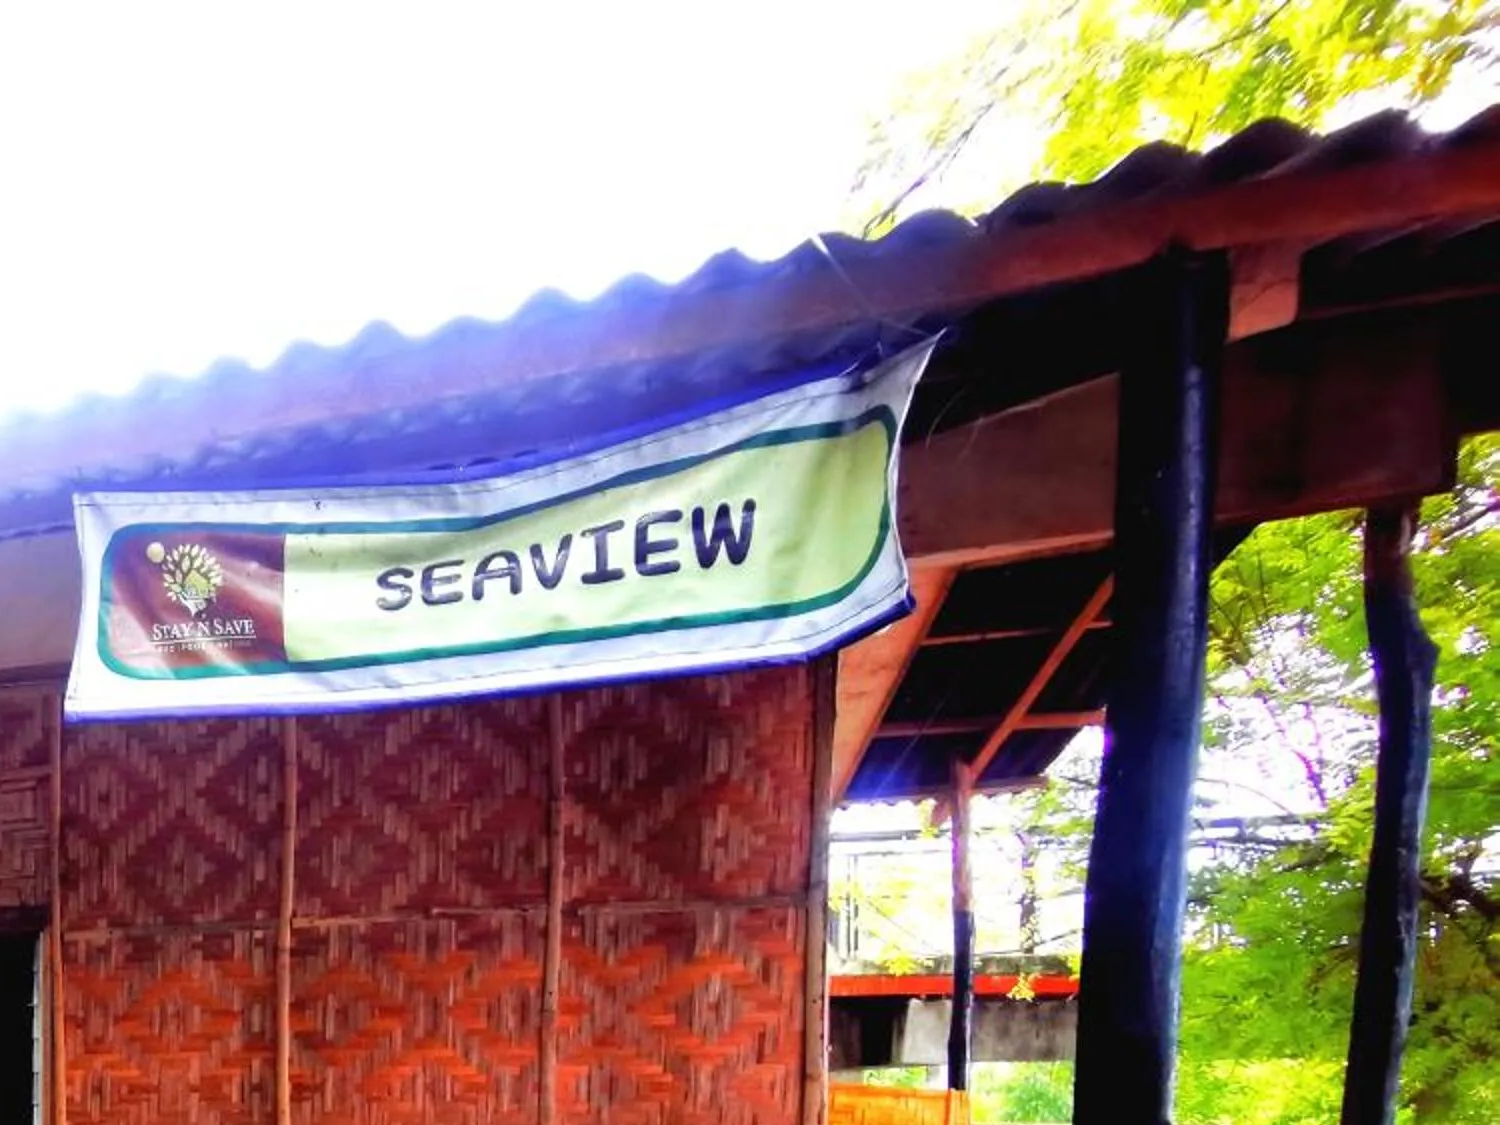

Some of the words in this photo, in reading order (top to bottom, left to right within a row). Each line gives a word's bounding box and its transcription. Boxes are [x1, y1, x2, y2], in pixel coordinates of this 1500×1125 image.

[376, 499, 756, 611] SEAVIEW
[153, 622, 194, 640] STAY
[213, 619, 254, 635] SAVE
